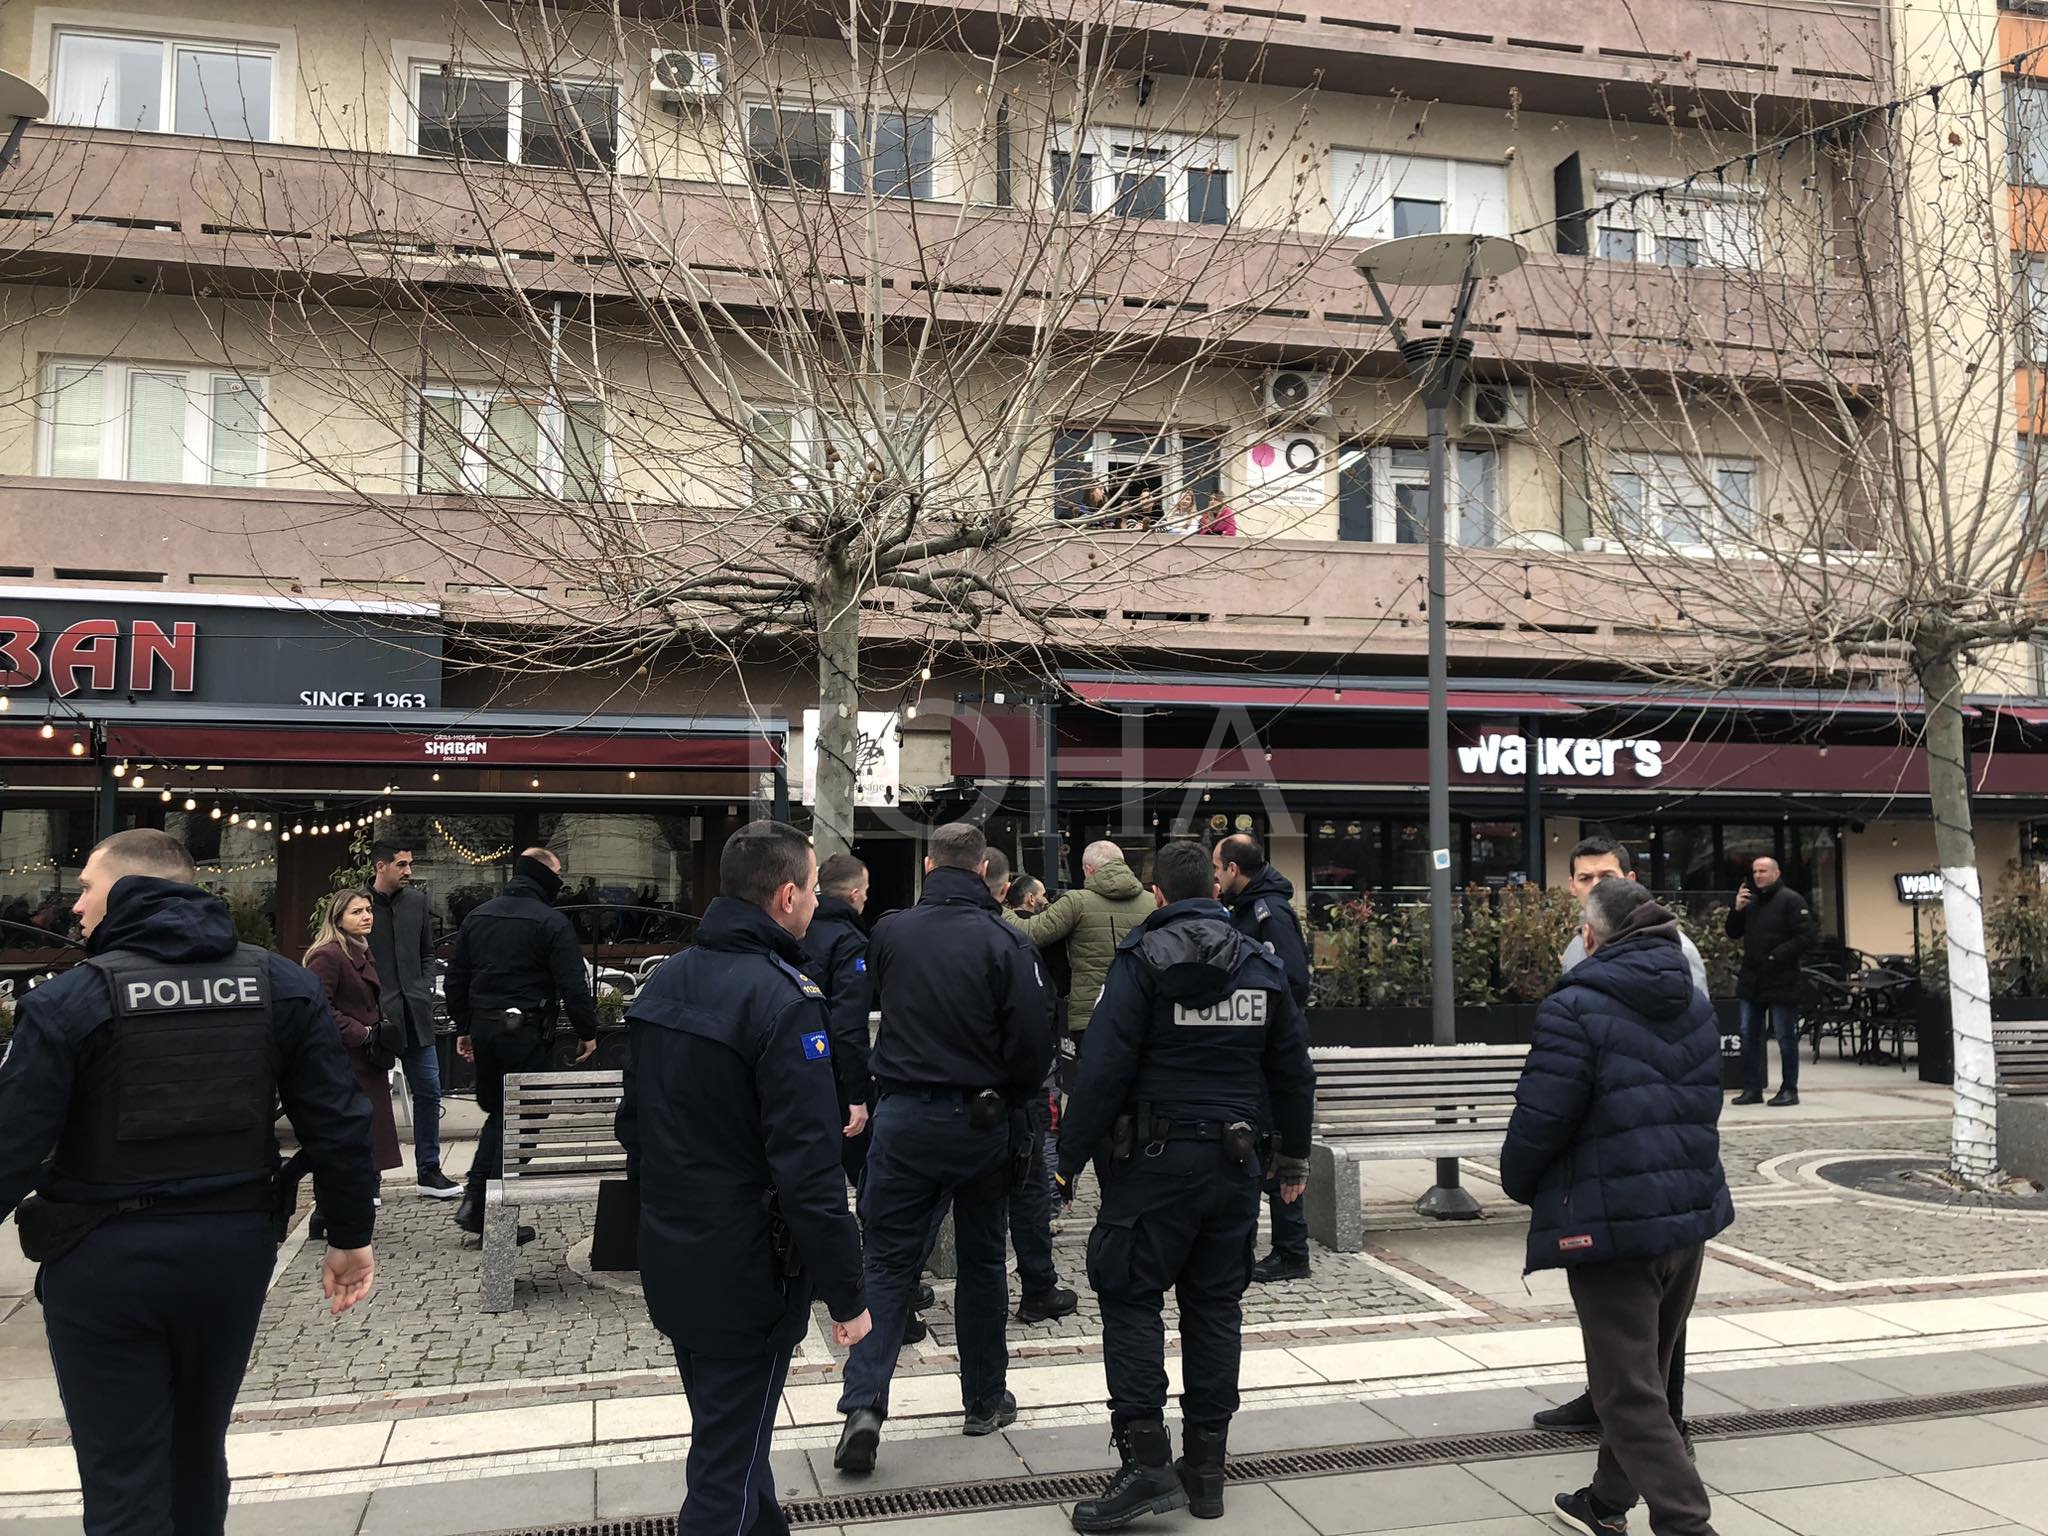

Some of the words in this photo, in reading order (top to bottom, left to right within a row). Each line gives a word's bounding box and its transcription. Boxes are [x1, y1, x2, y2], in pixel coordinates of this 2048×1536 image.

[0, 615, 197, 697] BAN
[300, 690, 365, 707] SINCE
[373, 692, 427, 708] 1963
[424, 742, 487, 755] SHABAN
[127, 977, 260, 1009] POLICE
